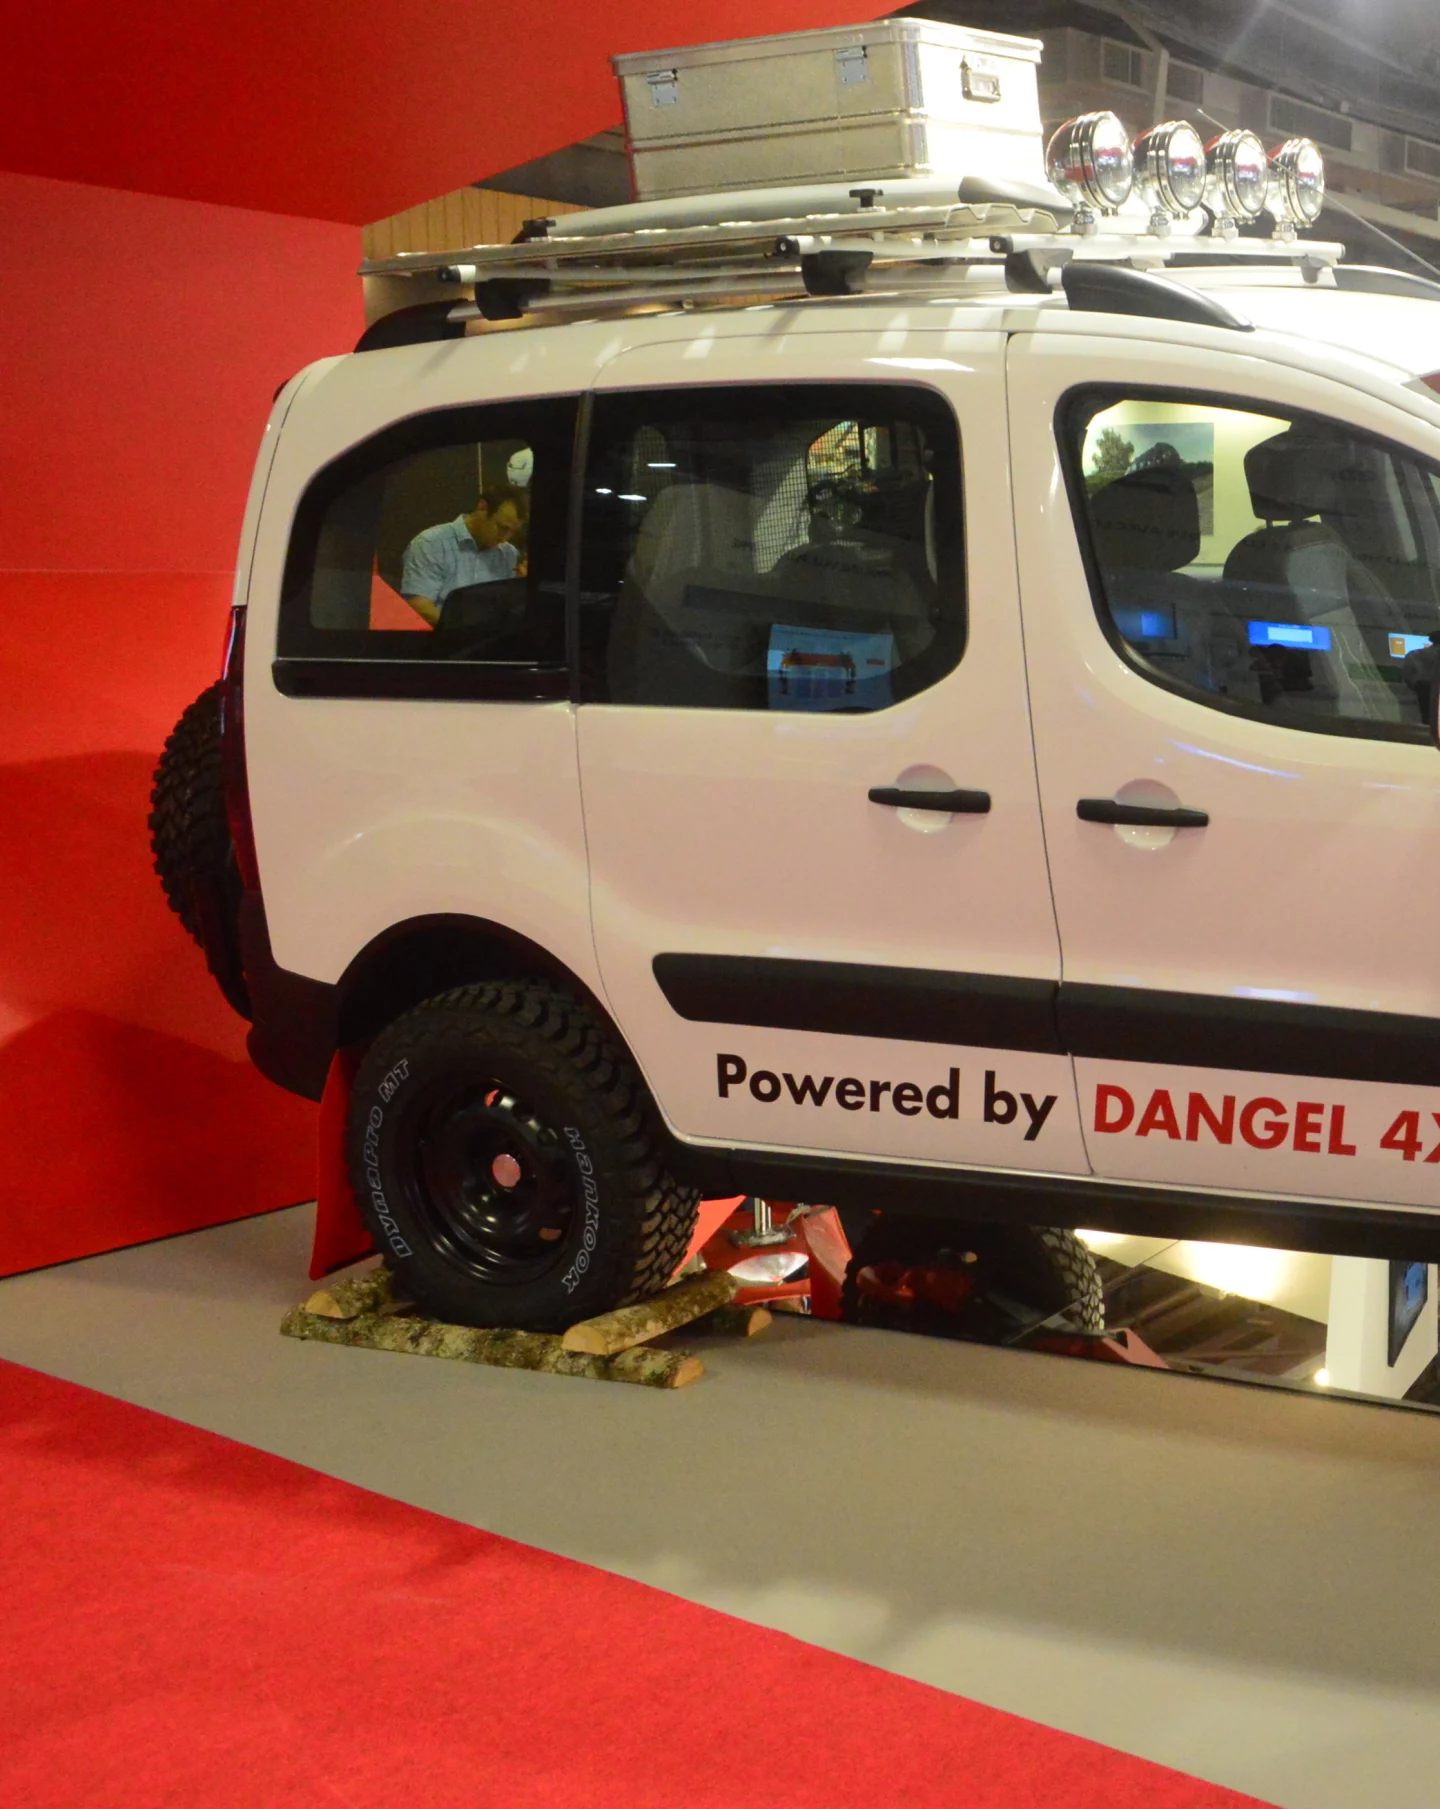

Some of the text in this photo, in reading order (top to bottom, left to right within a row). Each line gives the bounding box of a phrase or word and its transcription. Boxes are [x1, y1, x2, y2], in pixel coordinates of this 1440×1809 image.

[716, 1053, 1058, 1142] Powered by
[1093, 1083, 1357, 1157] DANGEL
